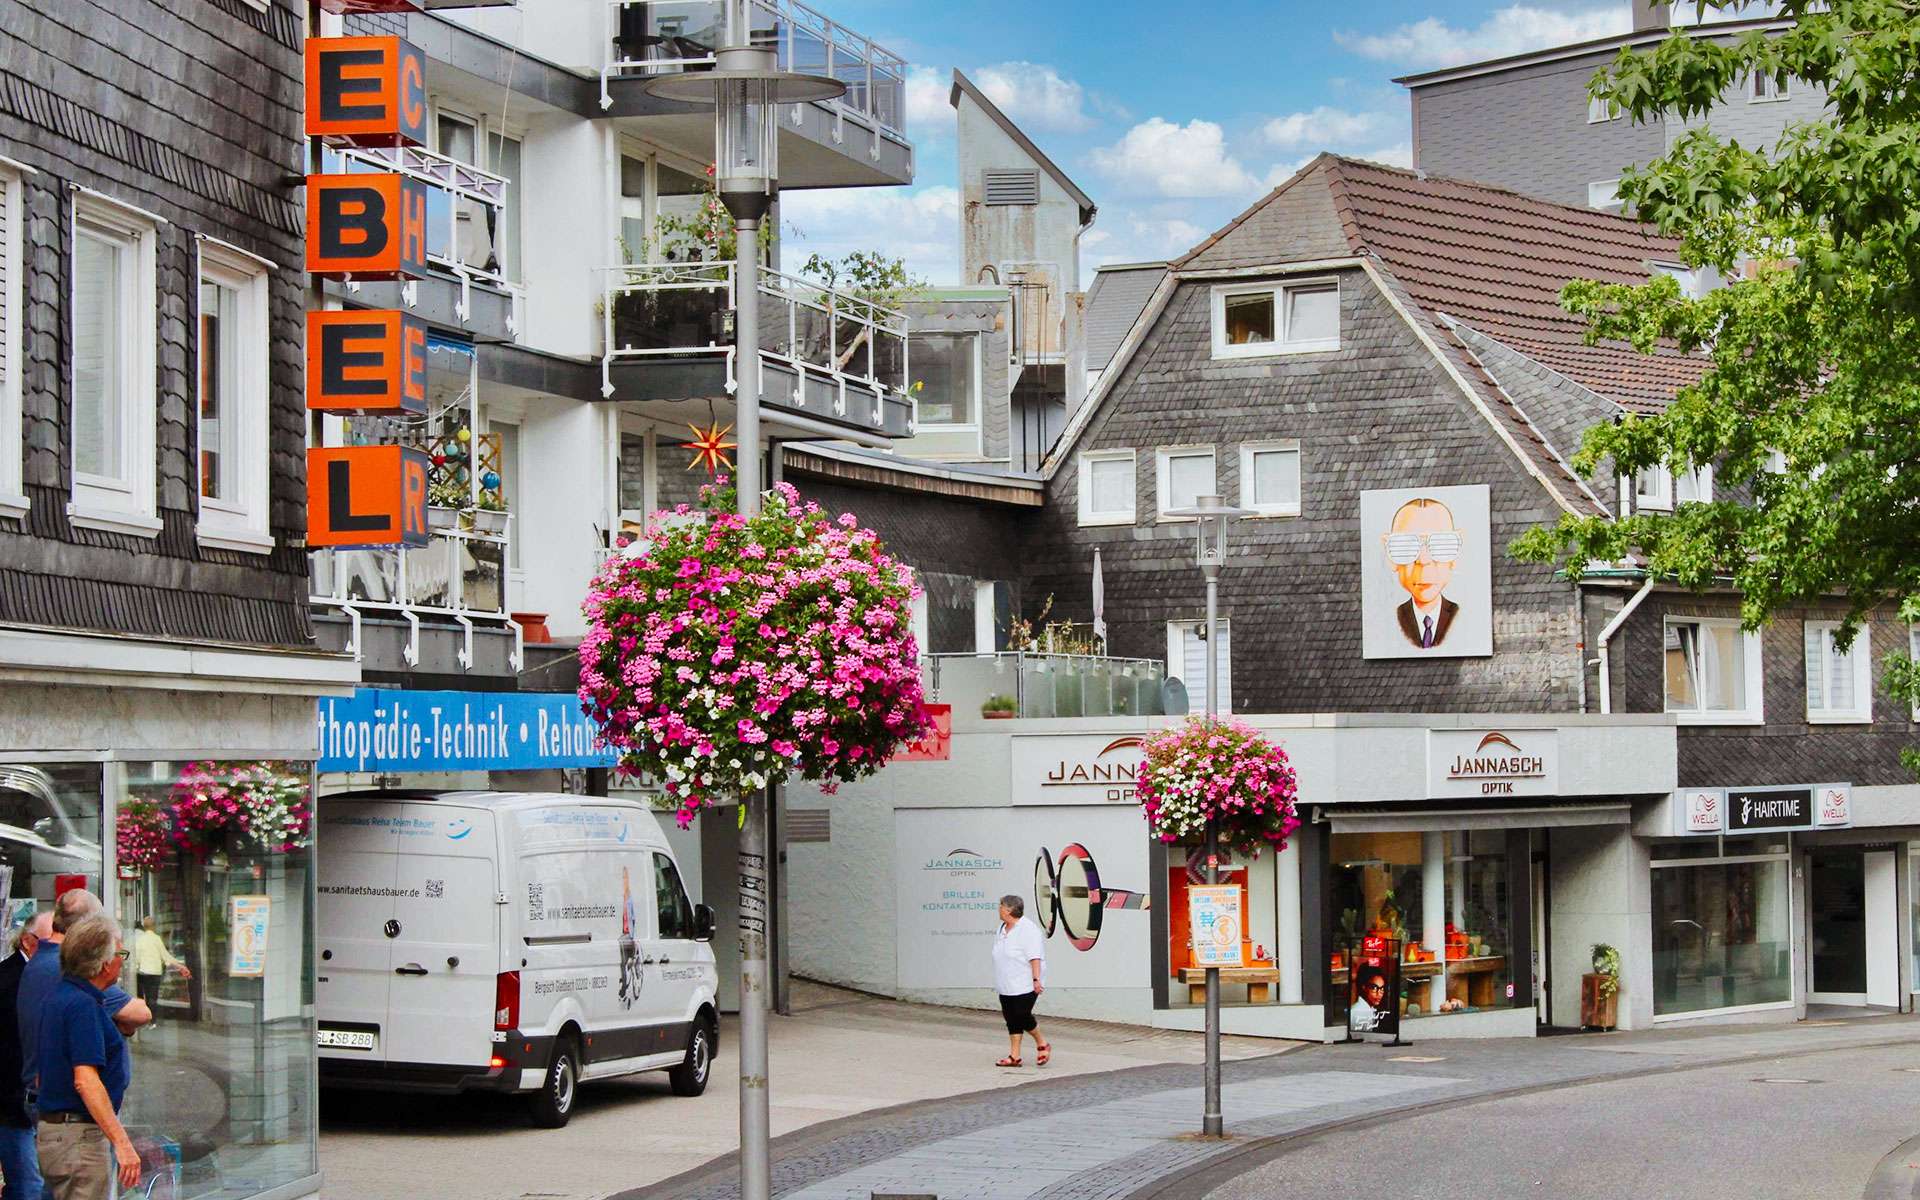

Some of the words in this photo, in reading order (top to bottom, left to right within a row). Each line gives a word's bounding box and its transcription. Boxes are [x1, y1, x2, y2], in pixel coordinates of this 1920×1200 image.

[538, 704, 613, 757] Rehab
[1450, 755, 1543, 773] JANNASCH
[1048, 761, 1135, 780] JANN
[1481, 782, 1513, 794] OPTIK
[1754, 799, 1800, 819] HAIRTIME
[1823, 808, 1847, 819] WELLA
[1692, 814, 1719, 825] WELLA
[926, 859, 1002, 868] JANNASCH
[922, 902, 999, 911] KONTAKTLINSE
